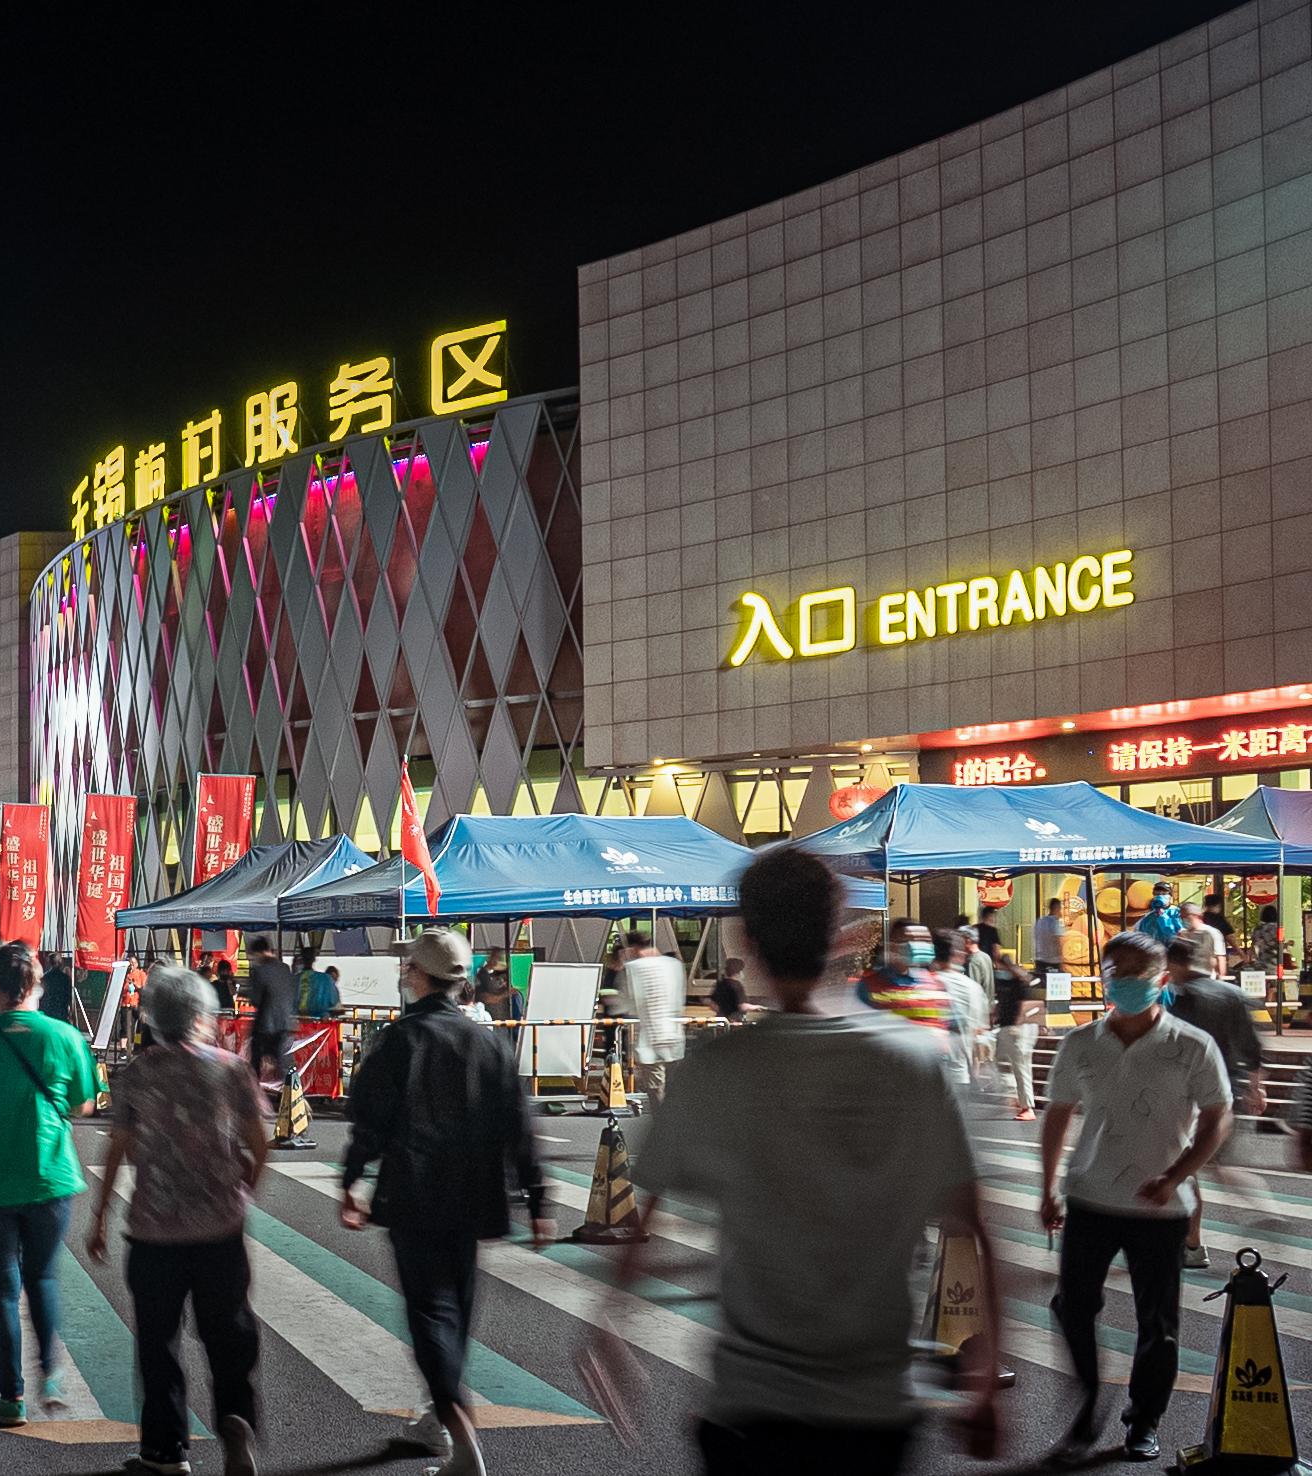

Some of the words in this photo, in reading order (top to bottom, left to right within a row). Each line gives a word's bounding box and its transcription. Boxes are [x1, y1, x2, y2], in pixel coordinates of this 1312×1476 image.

[71, 319, 508, 543] 无锡梅村服务区
[729, 586, 857, 668] 入口
[878, 548, 1135, 645] ENTRANCE
[5, 836, 21, 901] 盛世华诞
[22, 859, 38, 921] 祖国万岁
[87, 829, 107, 899] 盛世华诞
[104, 854, 125, 924] 祖国万岁
